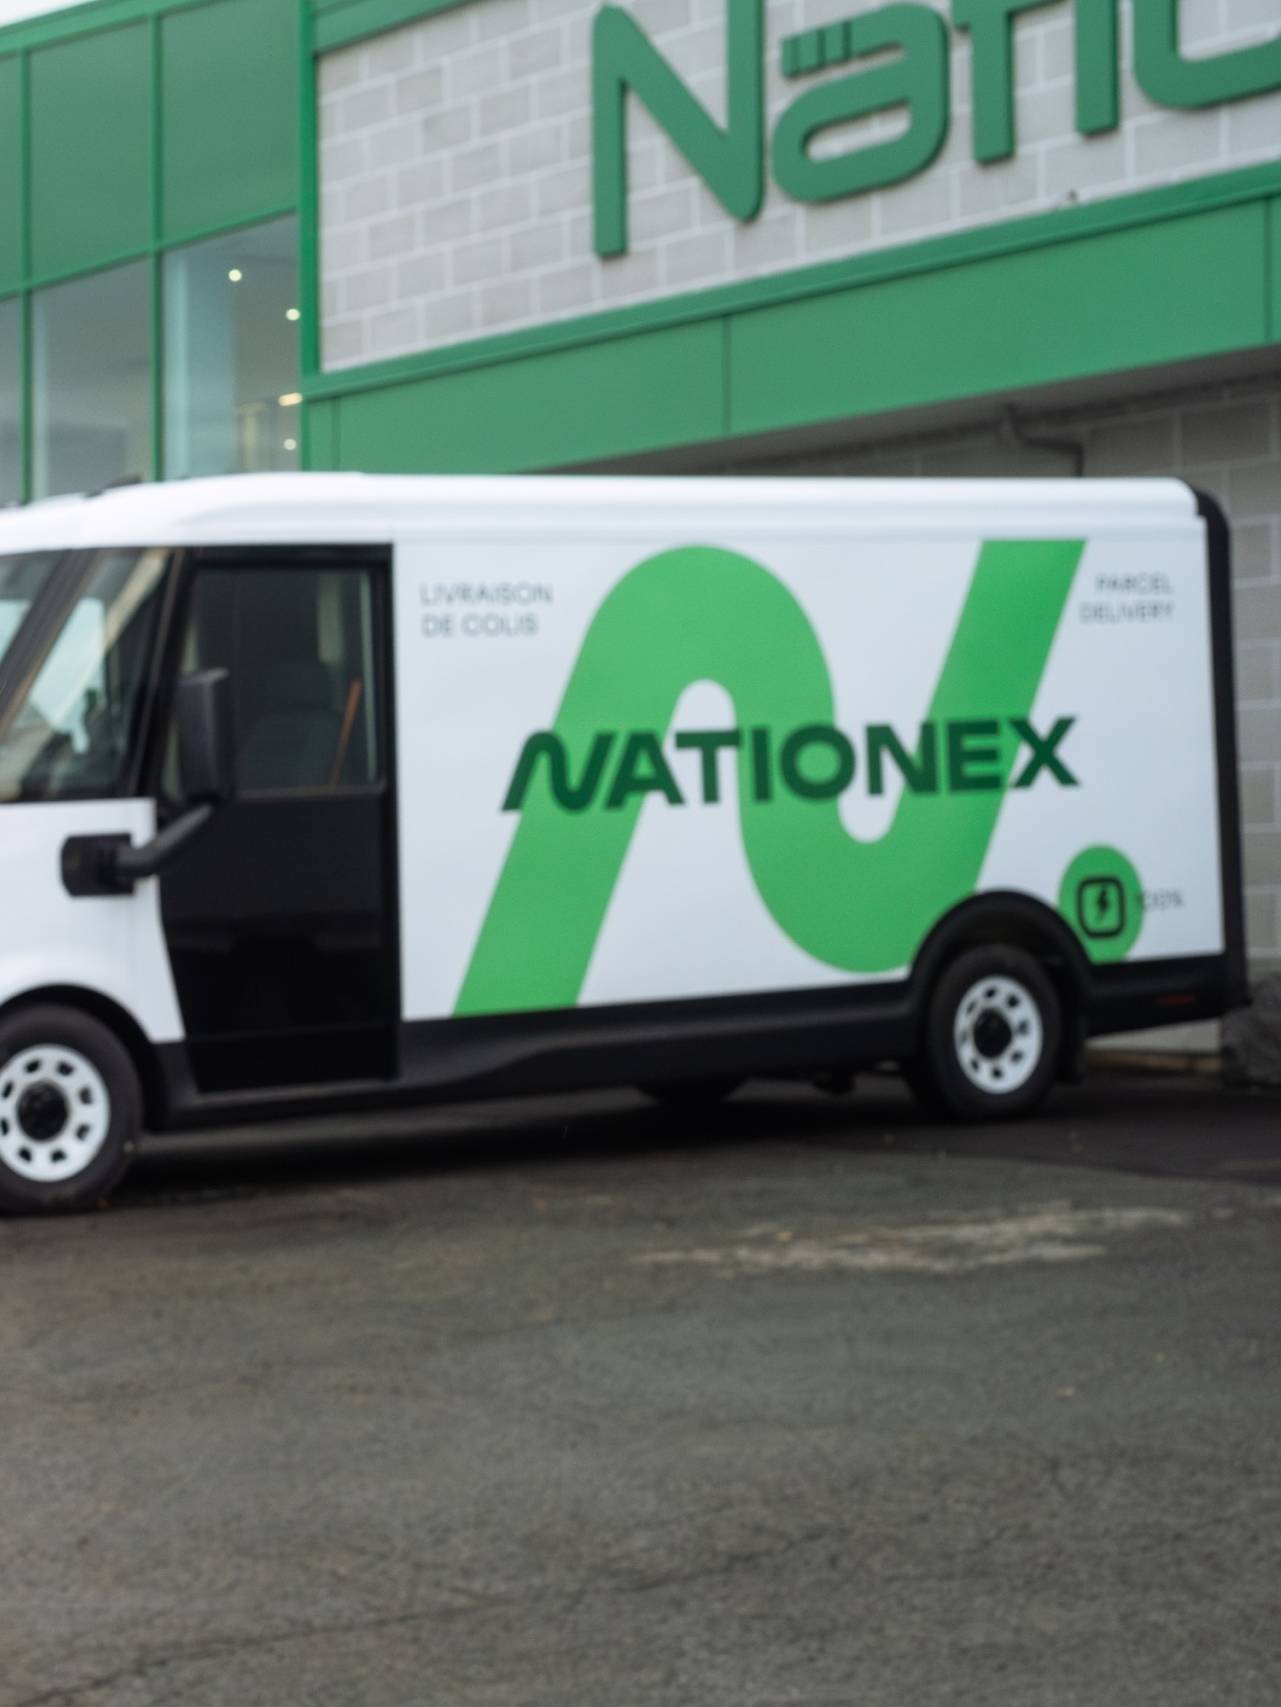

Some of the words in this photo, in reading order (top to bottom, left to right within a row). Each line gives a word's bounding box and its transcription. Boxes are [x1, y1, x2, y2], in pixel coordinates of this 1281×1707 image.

[420, 582, 554, 606] LIVRAISON
[1095, 573, 1174, 595] PARCEL
[1080, 600, 1174, 624] DELIVERY
[422, 614, 452, 637] DE
[461, 613, 539, 637] COLIS
[501, 716, 1079, 814] NATIONEX
